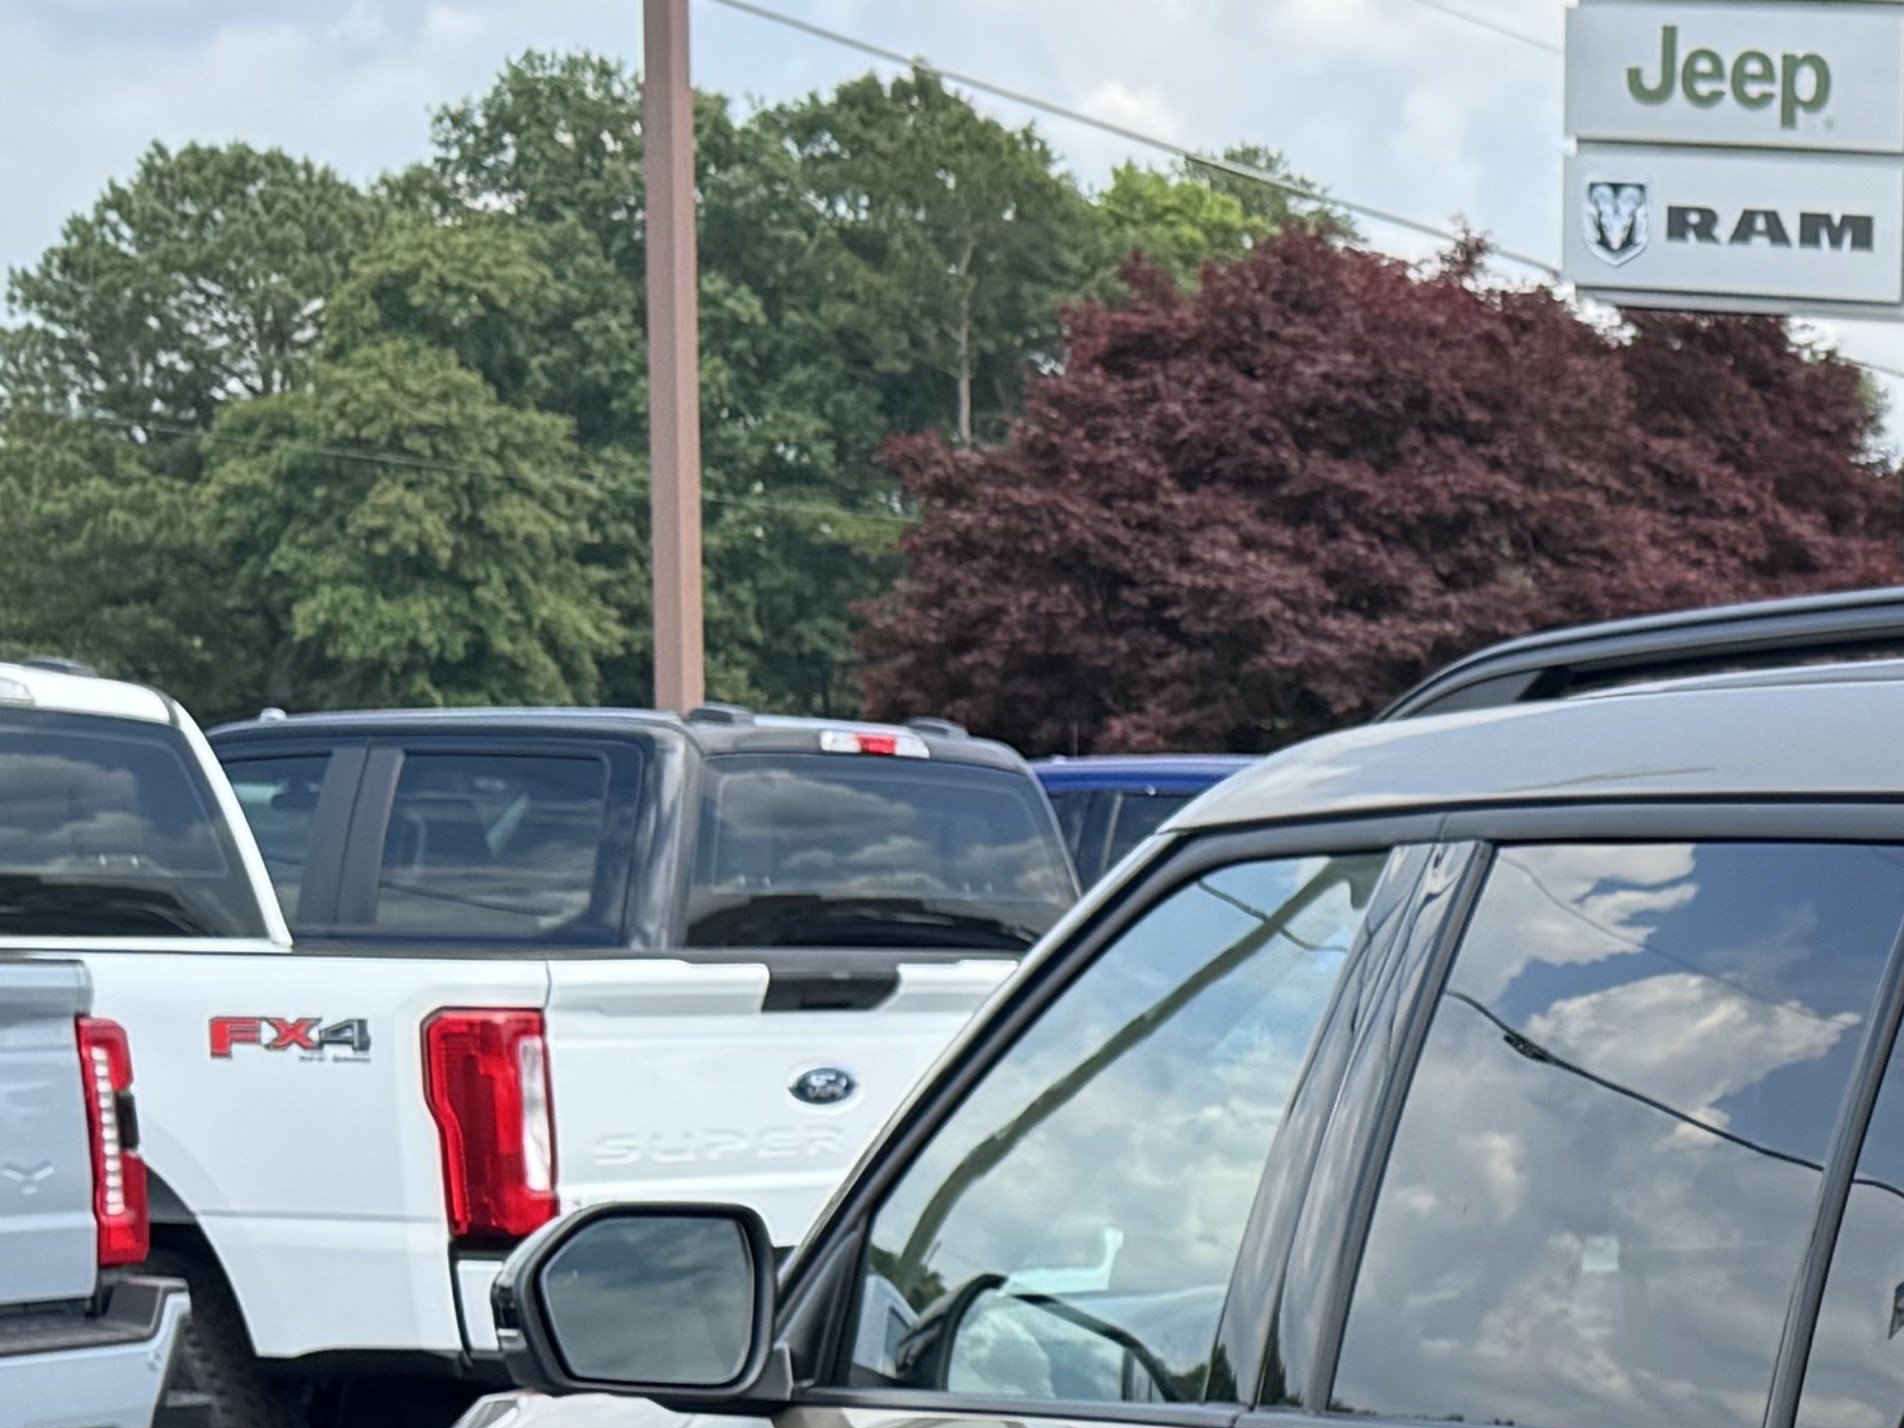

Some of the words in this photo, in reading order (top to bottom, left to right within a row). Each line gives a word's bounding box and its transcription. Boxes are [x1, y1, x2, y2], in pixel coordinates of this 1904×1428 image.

[1626, 25, 1832, 128] Jeep
[1666, 204, 1874, 252] RAM
[209, 1016, 371, 1058] FX4
